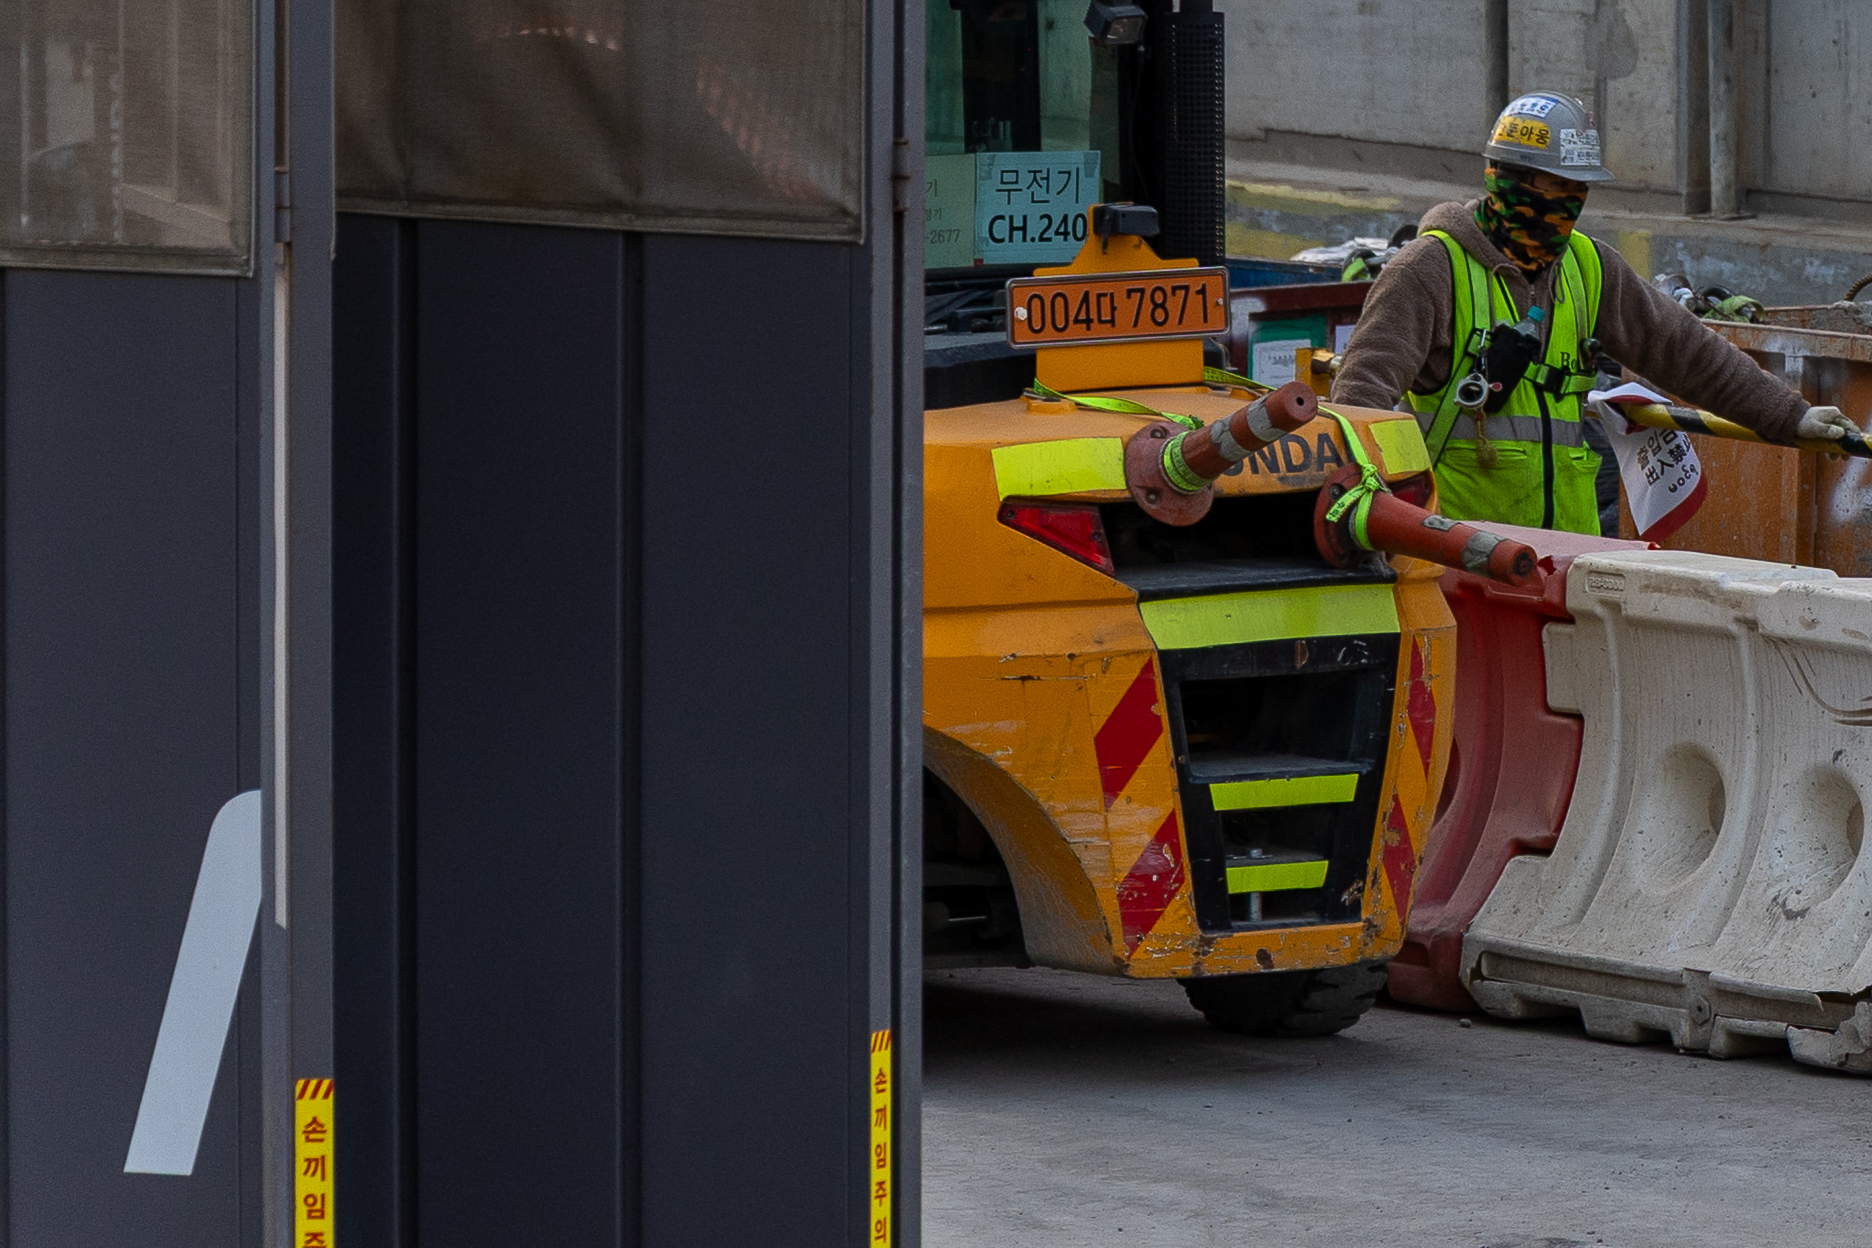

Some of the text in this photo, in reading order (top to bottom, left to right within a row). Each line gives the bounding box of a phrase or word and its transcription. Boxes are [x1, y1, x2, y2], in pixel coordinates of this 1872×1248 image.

[995, 166, 1080, 205] 무전기
[988, 212, 1088, 244] CH.240
[1125, 282, 1208, 328] 7871
